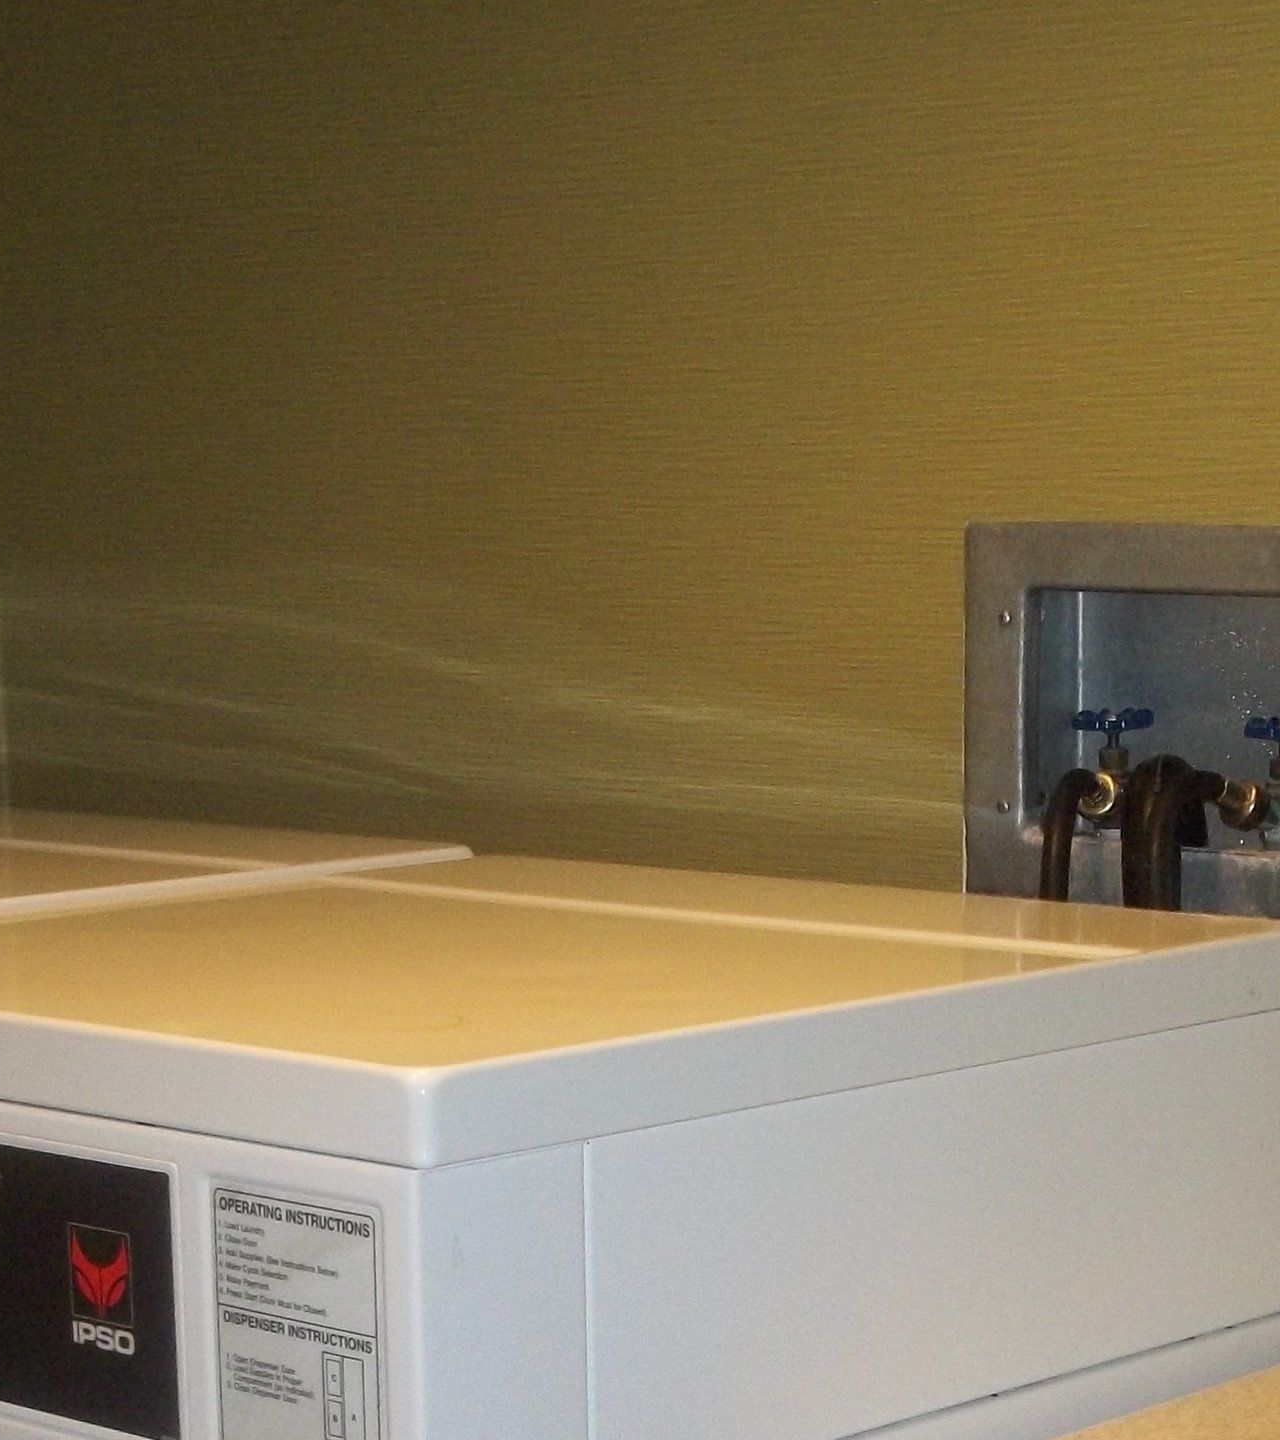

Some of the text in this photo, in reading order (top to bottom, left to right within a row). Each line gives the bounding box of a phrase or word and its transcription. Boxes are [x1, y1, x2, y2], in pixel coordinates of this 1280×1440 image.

[219, 1197, 371, 1238] OPERATING INSTRUCTIONS
[72, 1319, 135, 1356] IPSO
[223, 1310, 373, 1354] DISPENSER INSTRUCTIONS
